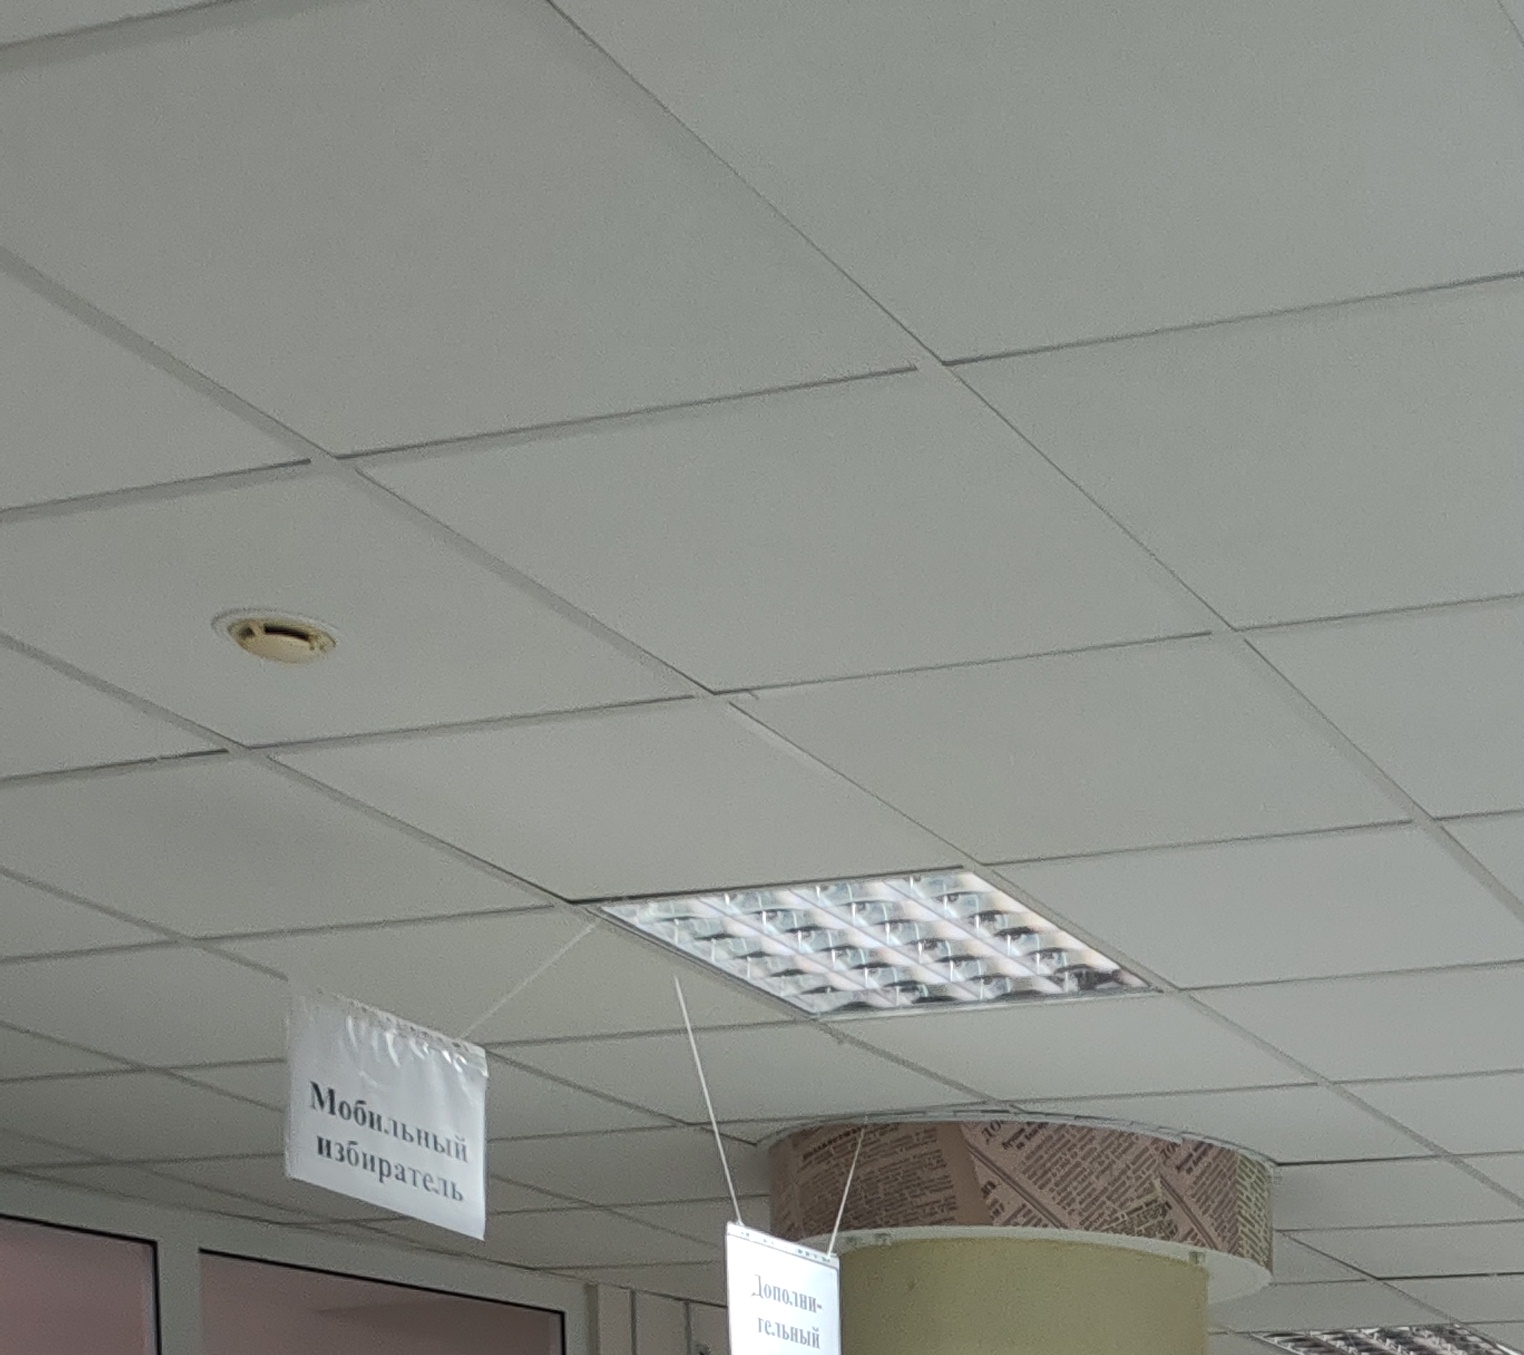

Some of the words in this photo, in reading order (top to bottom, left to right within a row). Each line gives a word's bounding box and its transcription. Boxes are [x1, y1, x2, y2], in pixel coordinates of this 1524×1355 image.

[309, 1080, 468, 1163] Мобильный
[316, 1135, 464, 1201] избиратель
[751, 1273, 823, 1314] Дополни-
